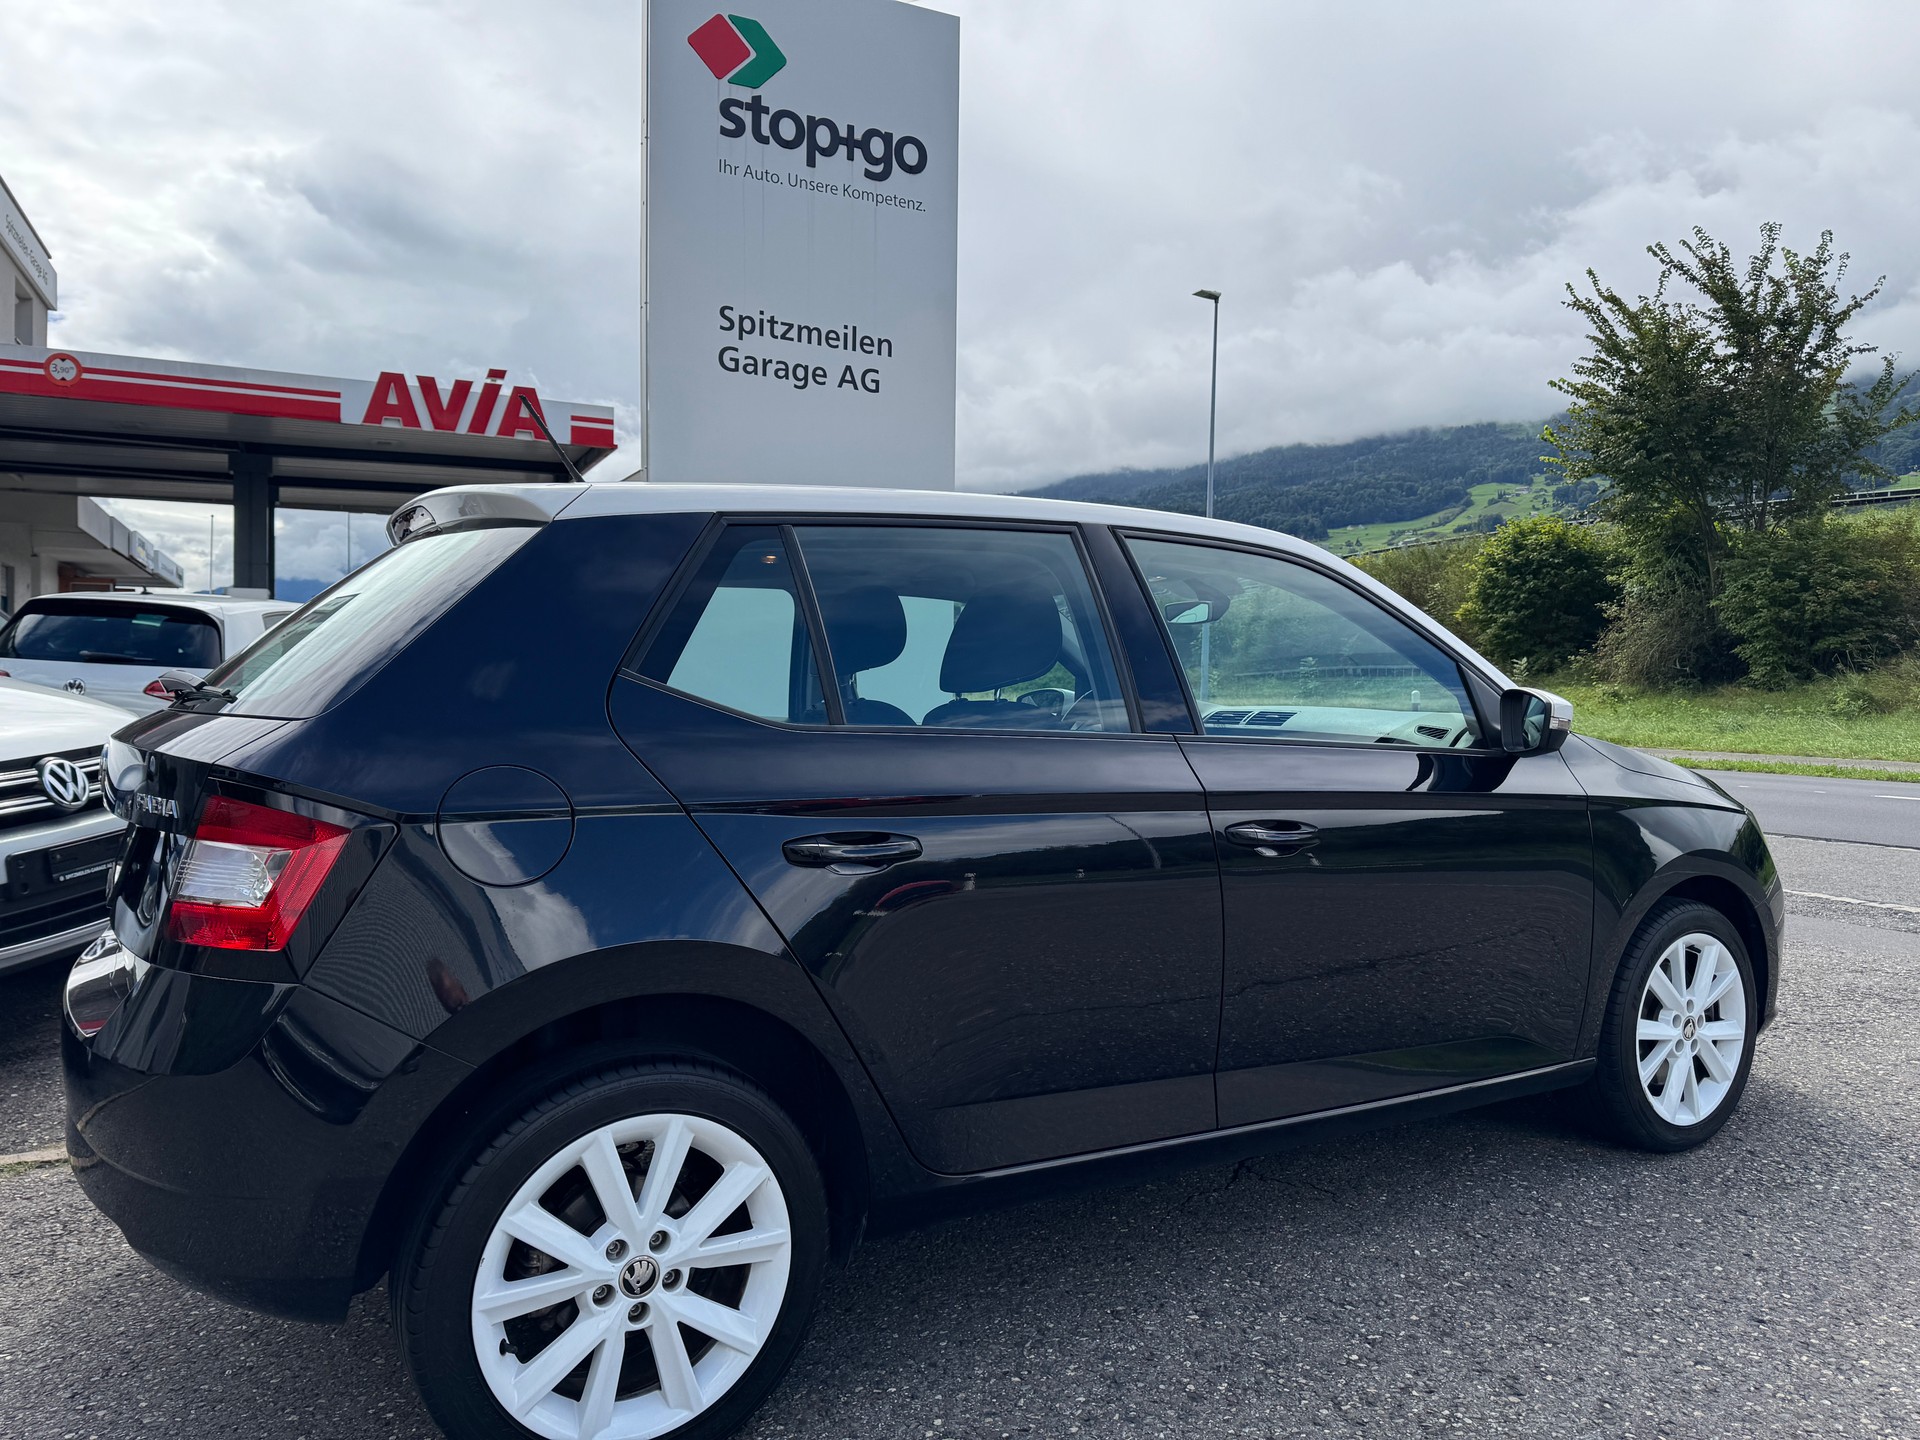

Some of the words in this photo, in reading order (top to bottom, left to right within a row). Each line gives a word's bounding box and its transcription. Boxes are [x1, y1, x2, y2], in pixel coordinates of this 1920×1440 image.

[719, 95, 928, 182] stop+go
[718, 158, 740, 176] Ihr
[743, 164, 784, 185] Auto.
[787, 172, 839, 196] Unsere
[842, 183, 927, 213] Kompetenz.
[718, 304, 893, 358] Spitzmeilen
[717, 345, 828, 390] Garage
[837, 364, 880, 394] AG
